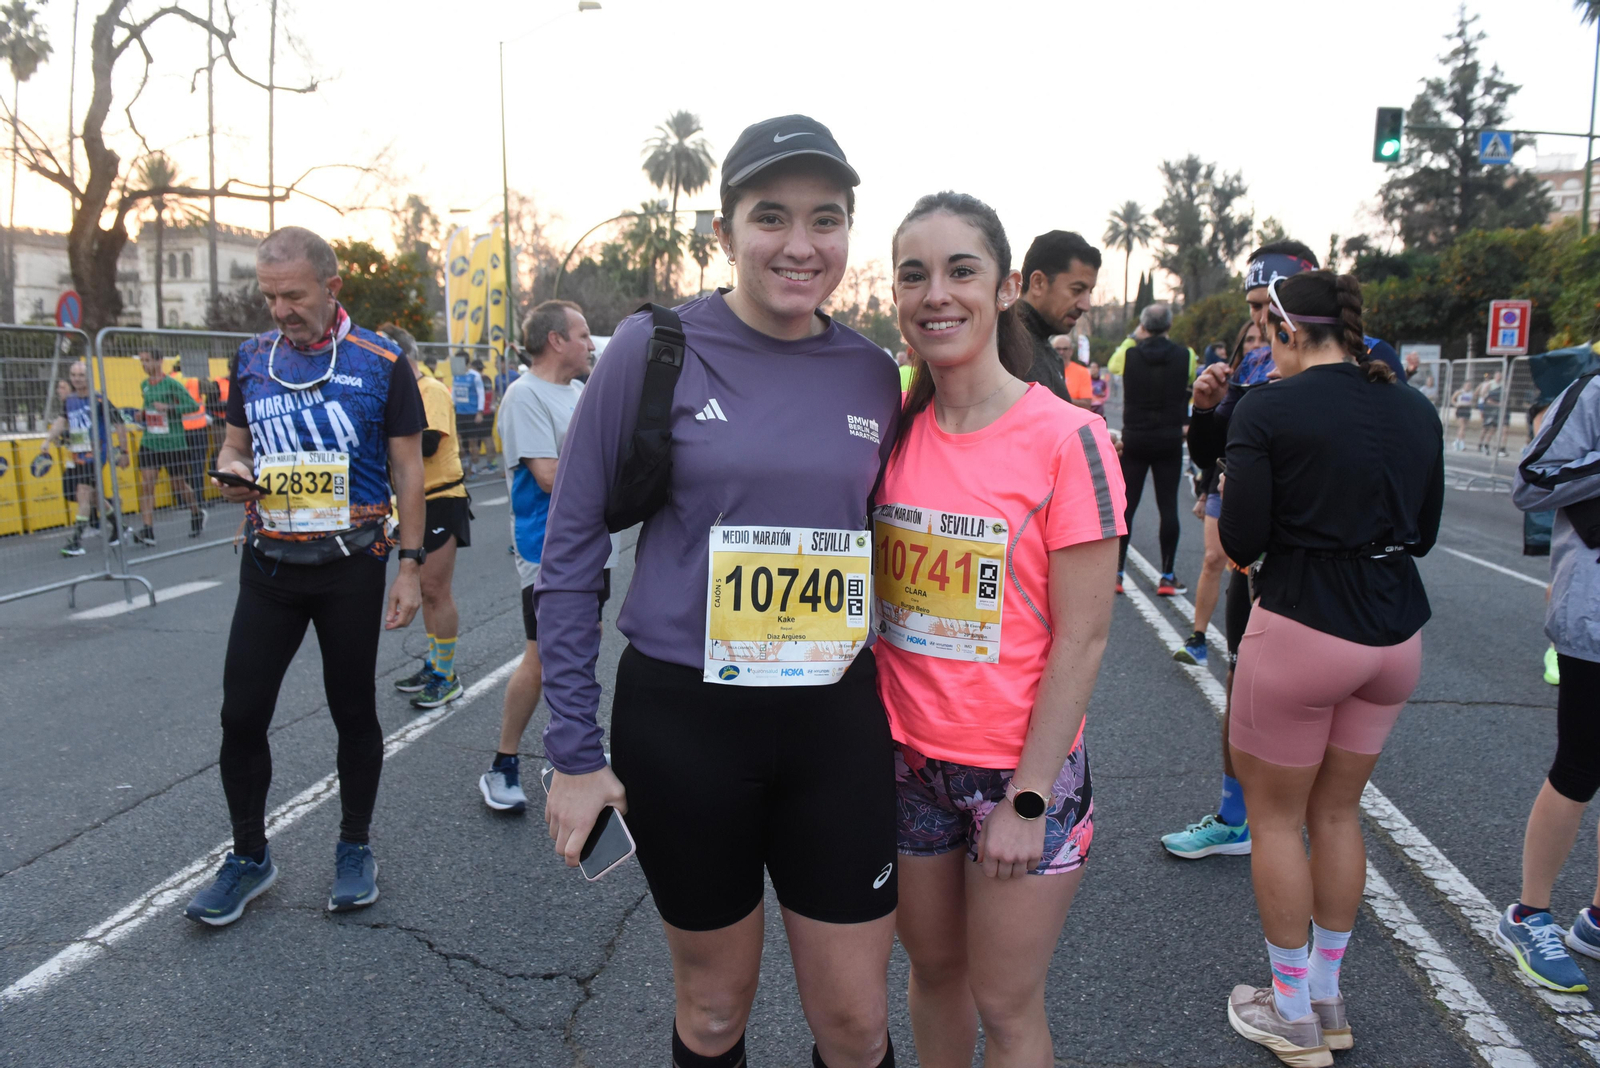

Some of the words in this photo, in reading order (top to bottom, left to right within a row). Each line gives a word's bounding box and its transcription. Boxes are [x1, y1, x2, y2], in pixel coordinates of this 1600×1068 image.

[329, 374, 363, 388] HOKA
[847, 414, 869, 427] BMW
[250, 401, 360, 456] EVILLA
[849, 423, 870, 433] BERLIN
[849, 429, 880, 444] MARATHON
[309, 452, 336, 463] SEVILLA
[262, 471, 332, 495] 12832
[940, 513, 985, 538] SEVILLA
[722, 530, 750, 545] MEDIO
[752, 529, 791, 546] MARATÓN
[811, 531, 850, 552] SEVILLA
[880, 535, 972, 594] 10741
[714, 584, 722, 608] CAJÓN
[725, 565, 845, 613] 10740
[904, 586, 927, 597] CLARA
[900, 601, 915, 610] Burgo
[906, 635, 927, 646] HOKA
[781, 668, 804, 677] HOKA
